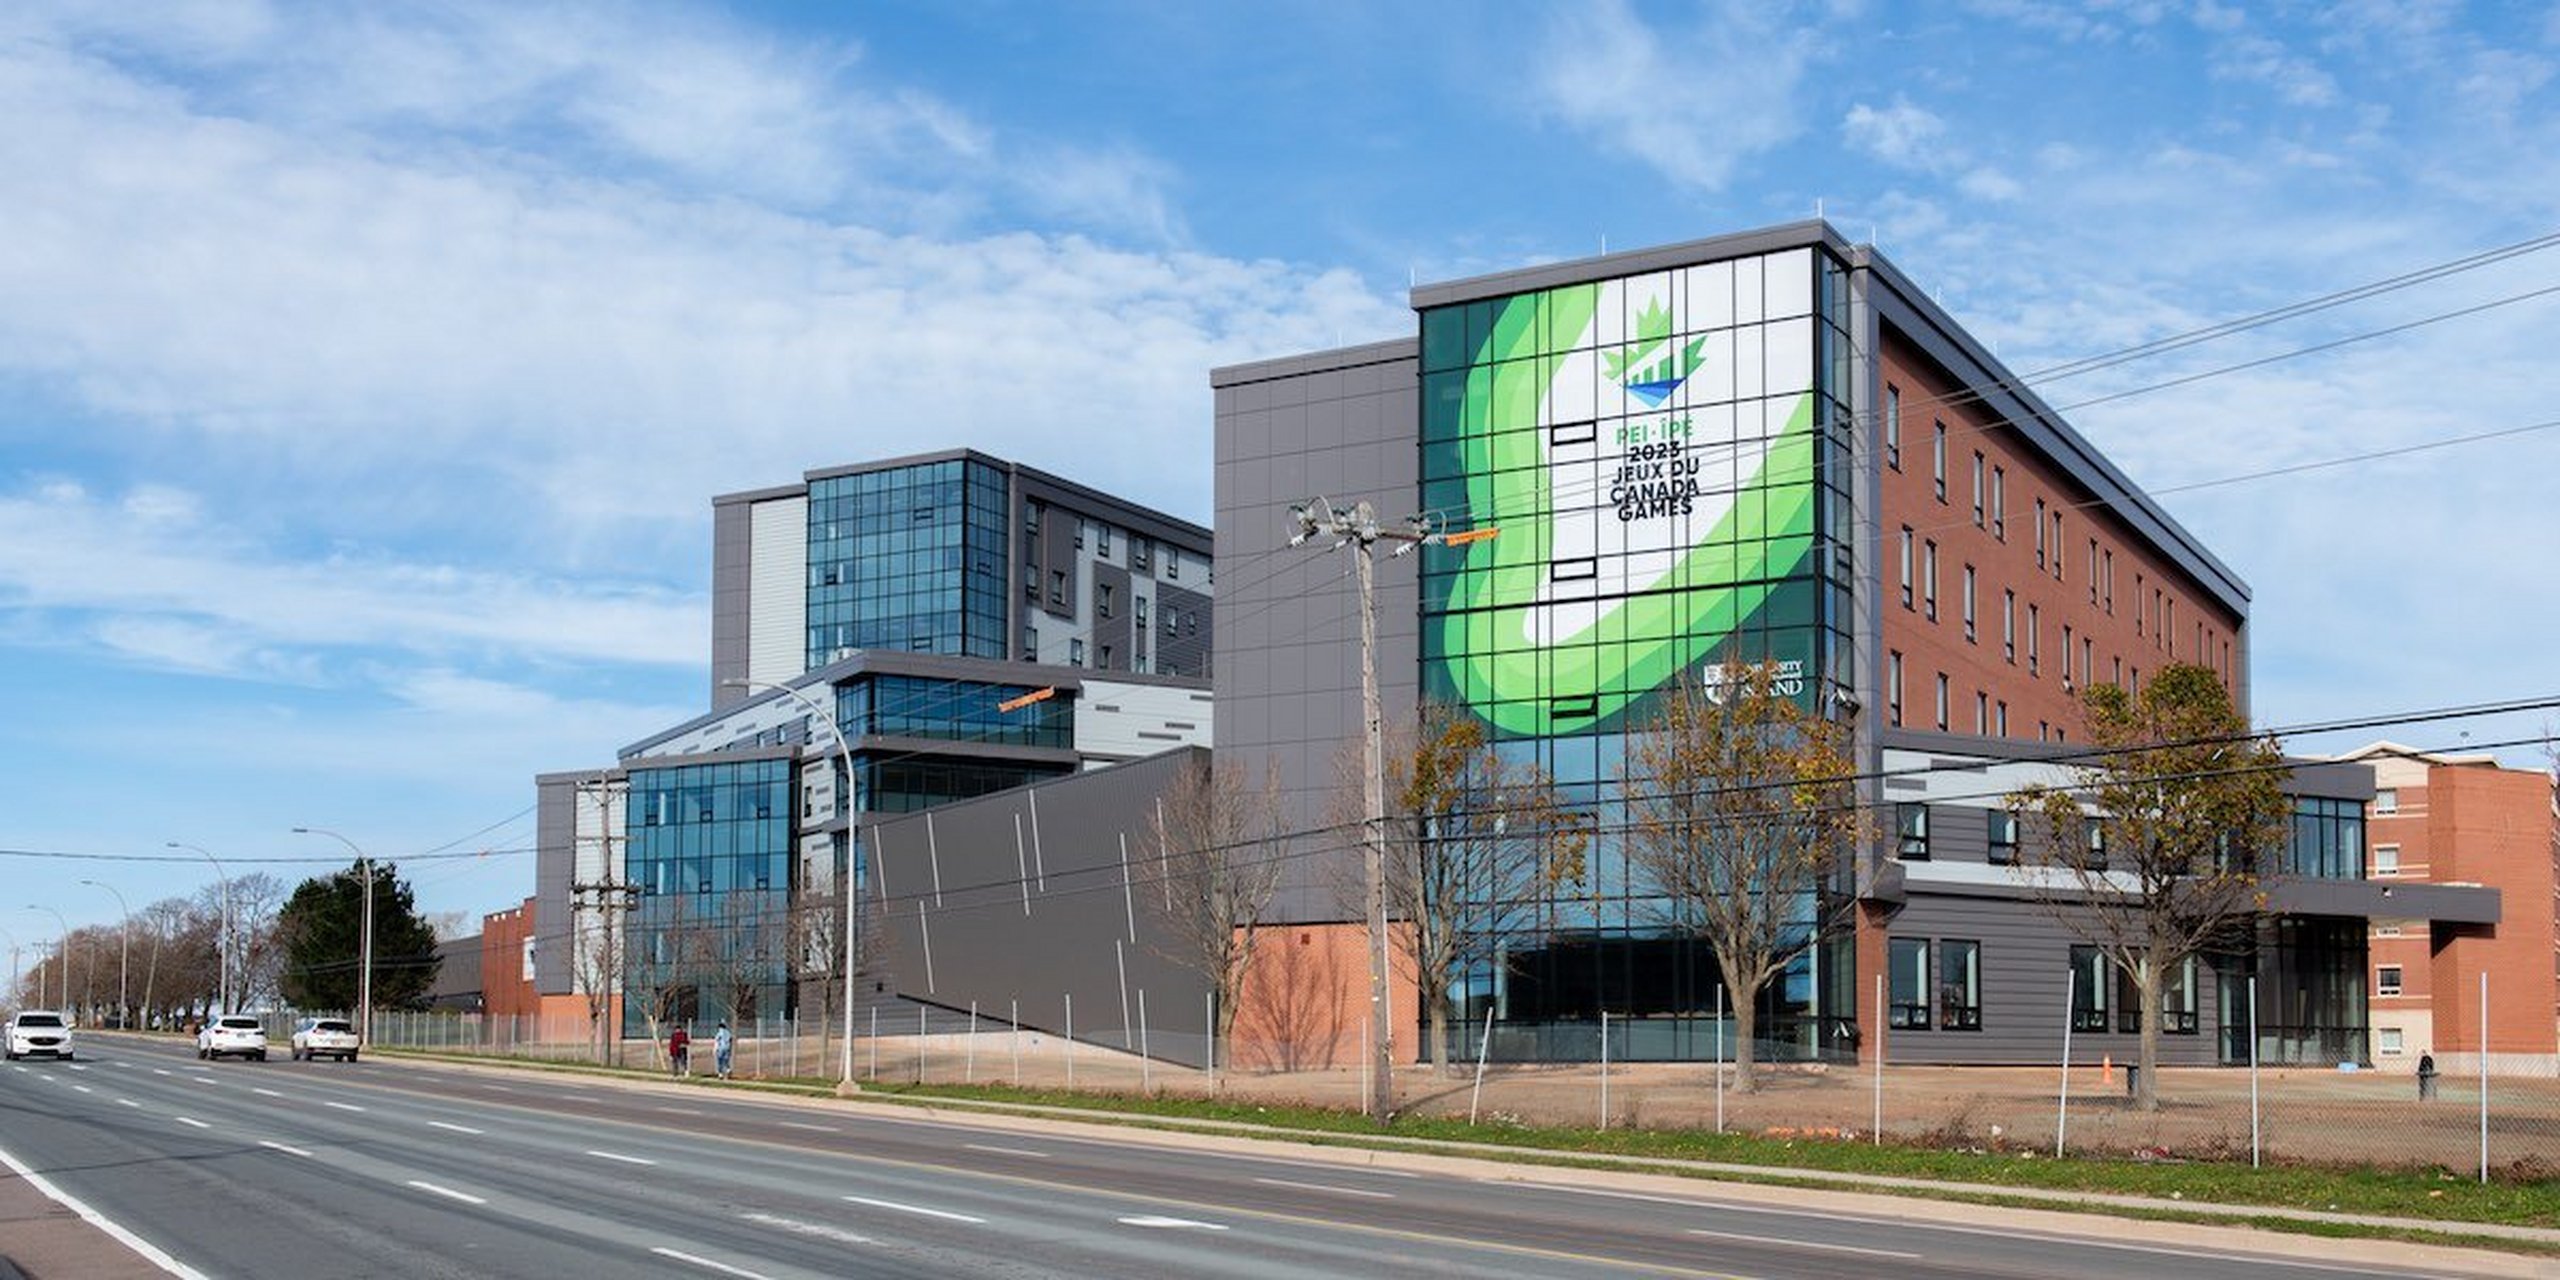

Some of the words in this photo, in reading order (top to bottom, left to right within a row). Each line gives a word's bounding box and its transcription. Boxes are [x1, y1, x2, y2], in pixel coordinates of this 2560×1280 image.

[1629, 441, 1681, 462] 2023
[1613, 462, 1664, 484] JEUX
[1671, 458, 1699, 477] DU
[1610, 478, 1700, 505] CANADA
[1618, 497, 1693, 522] GAMES
